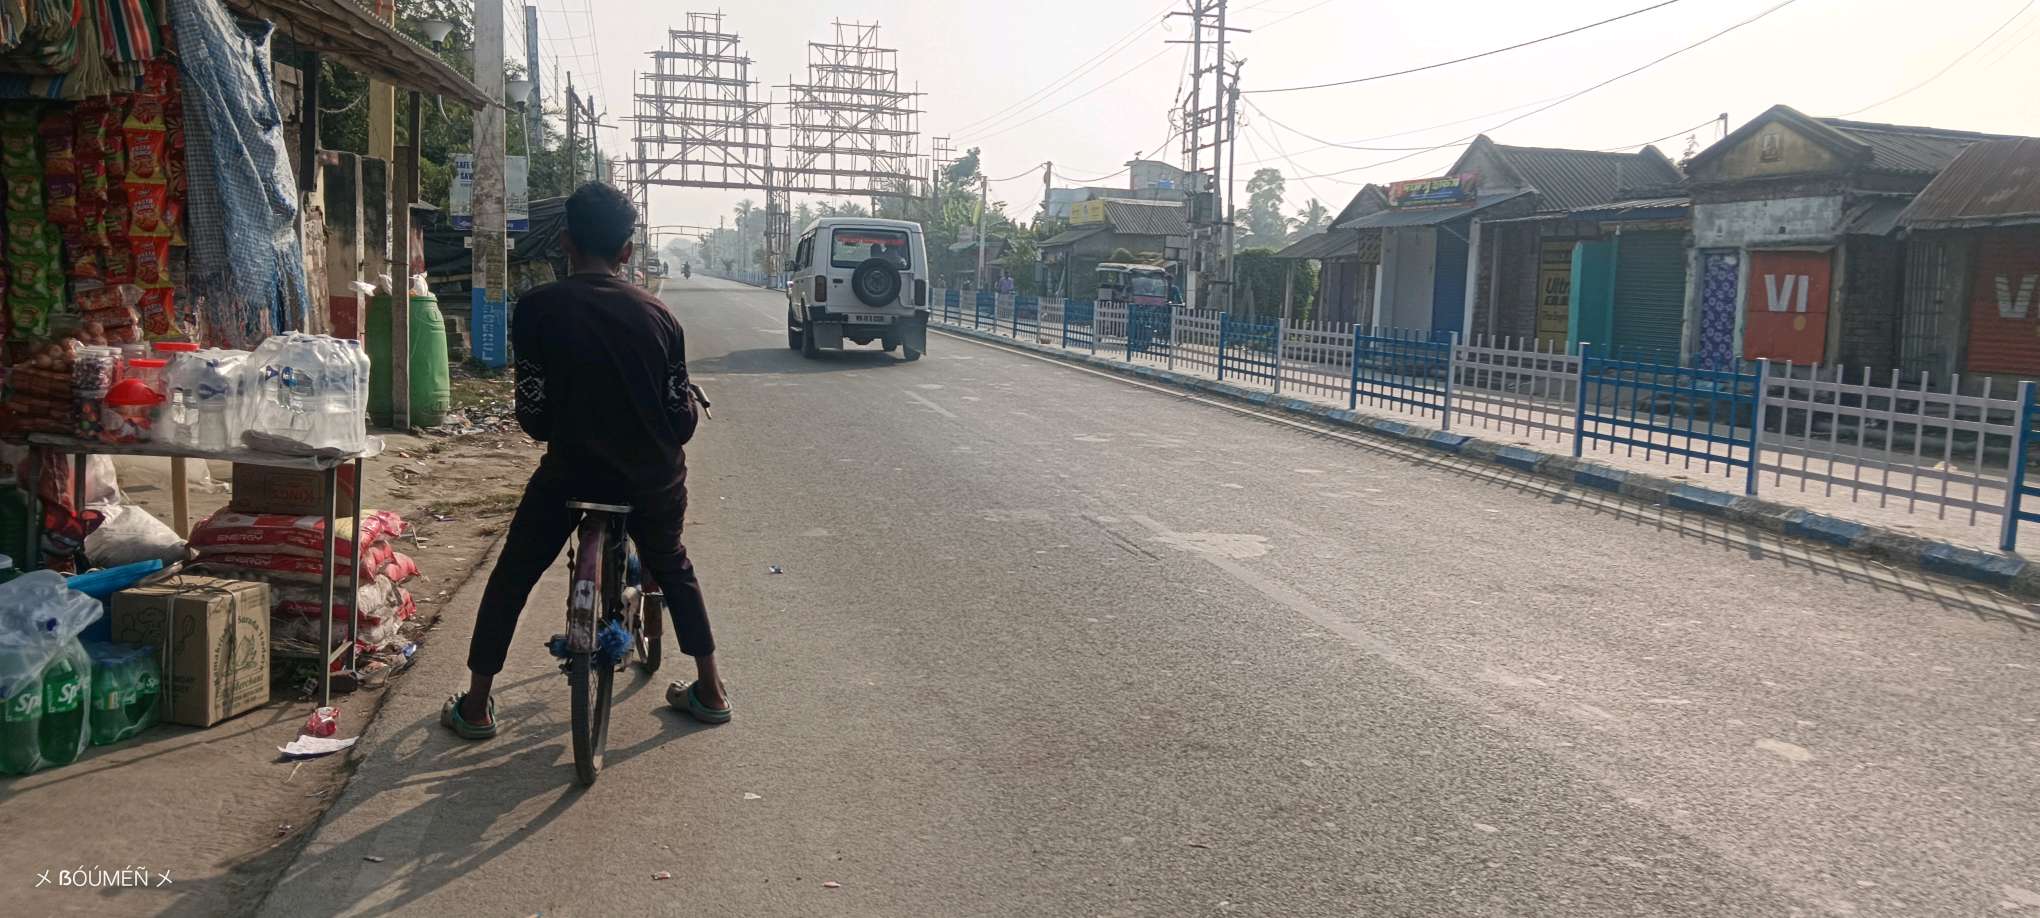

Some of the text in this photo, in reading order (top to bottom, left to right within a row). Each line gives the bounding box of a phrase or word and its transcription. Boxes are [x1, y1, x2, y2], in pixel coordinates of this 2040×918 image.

[1764, 274, 1809, 313] VI
[1995, 272, 2040, 319] V
[216, 533, 264, 542] ENERGY
[224, 555, 272, 566] ENERGY
